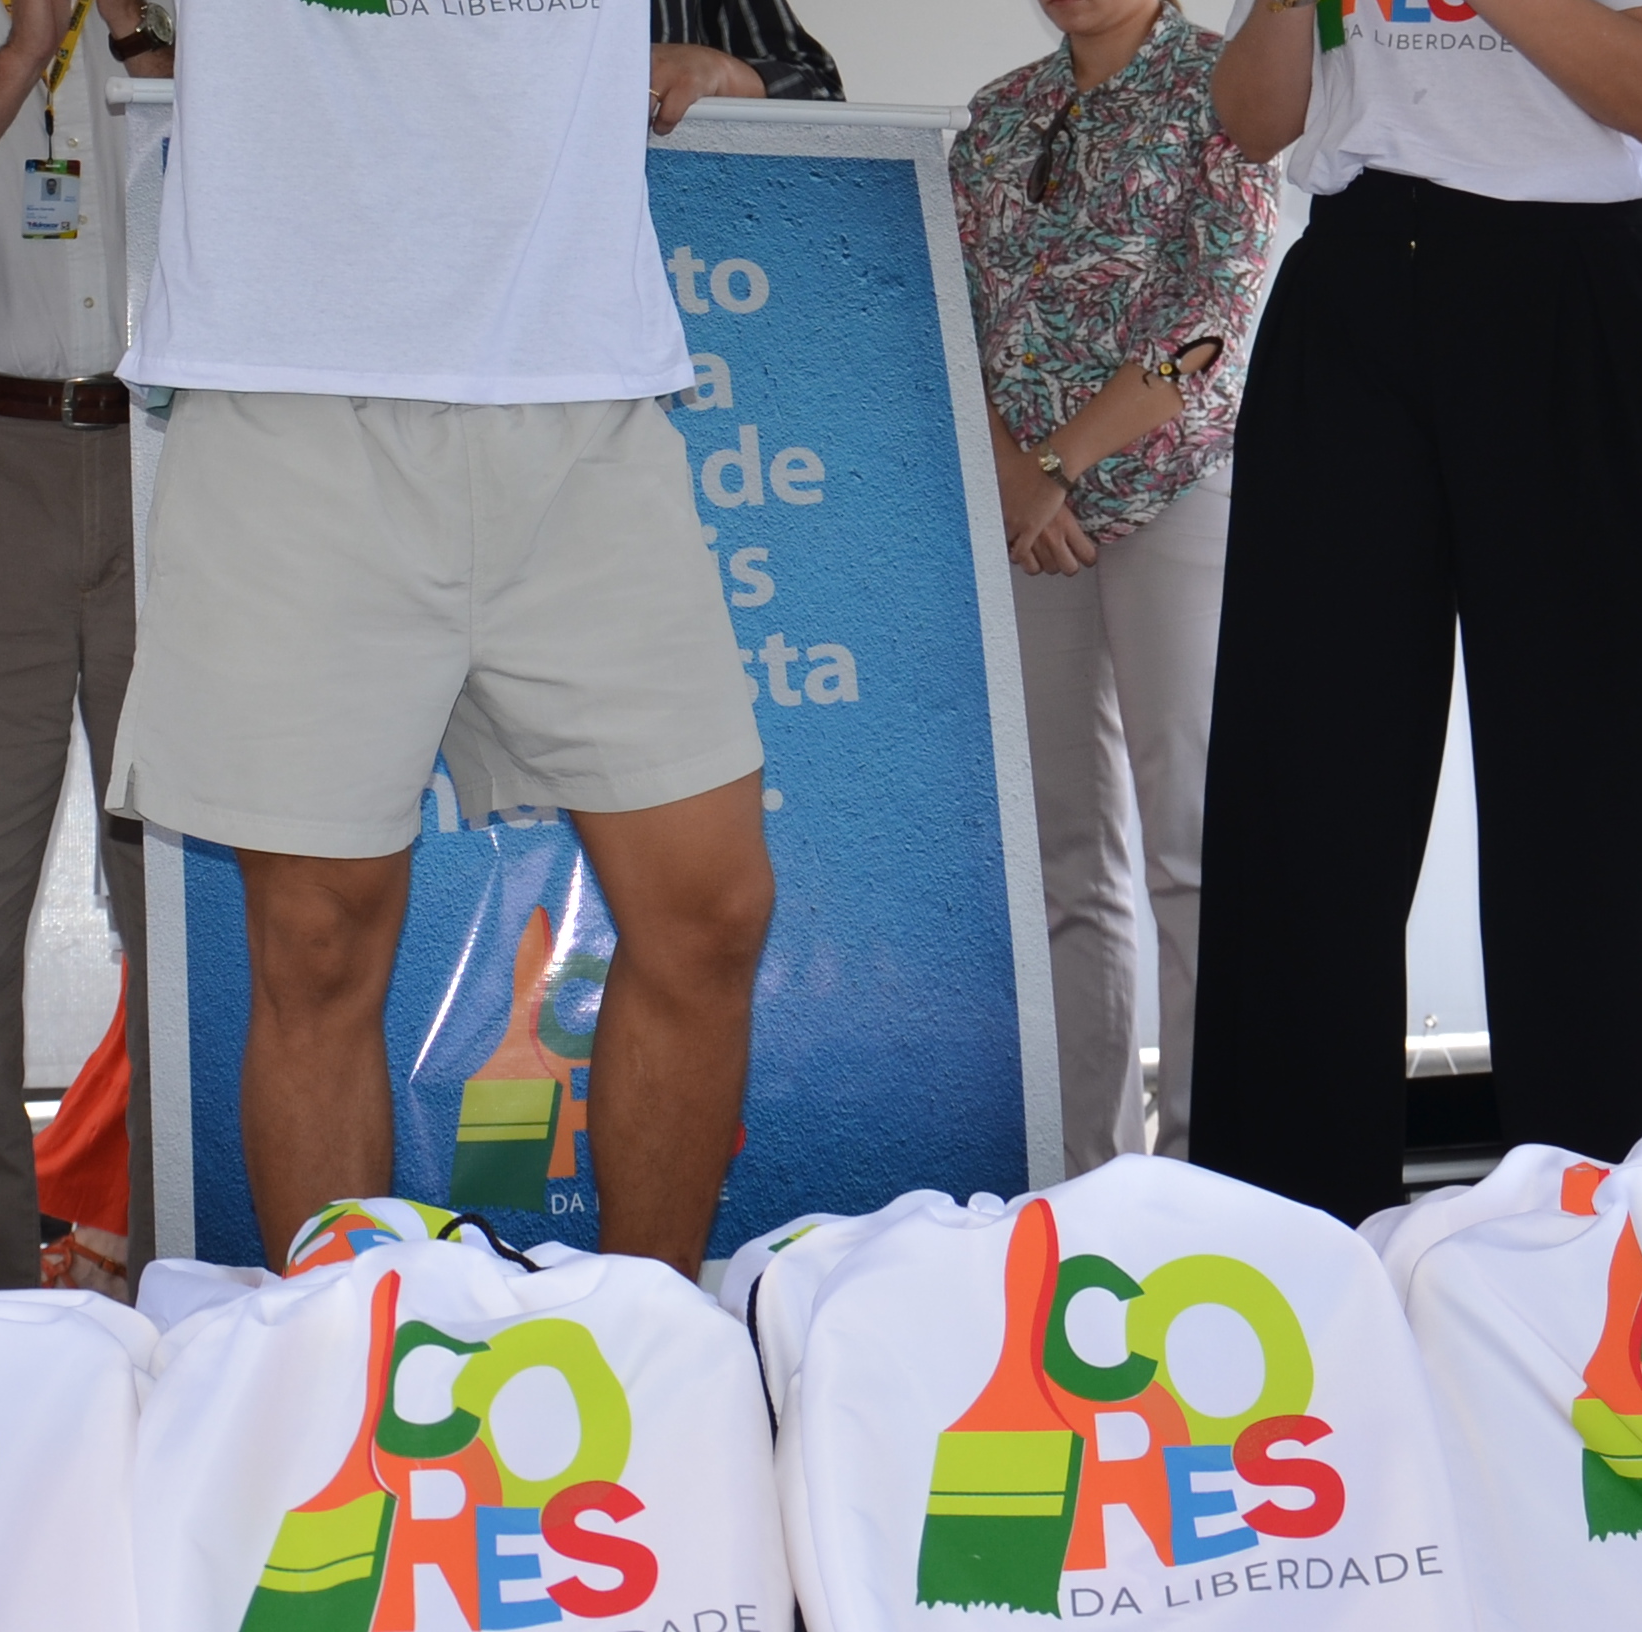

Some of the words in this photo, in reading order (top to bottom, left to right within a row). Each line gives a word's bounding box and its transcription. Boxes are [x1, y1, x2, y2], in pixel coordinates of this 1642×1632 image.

[1374, 29, 1514, 53] LIBERDADE
[1071, 1587, 1142, 1618] DA
[1165, 1546, 1444, 1608] LIBERDADE
